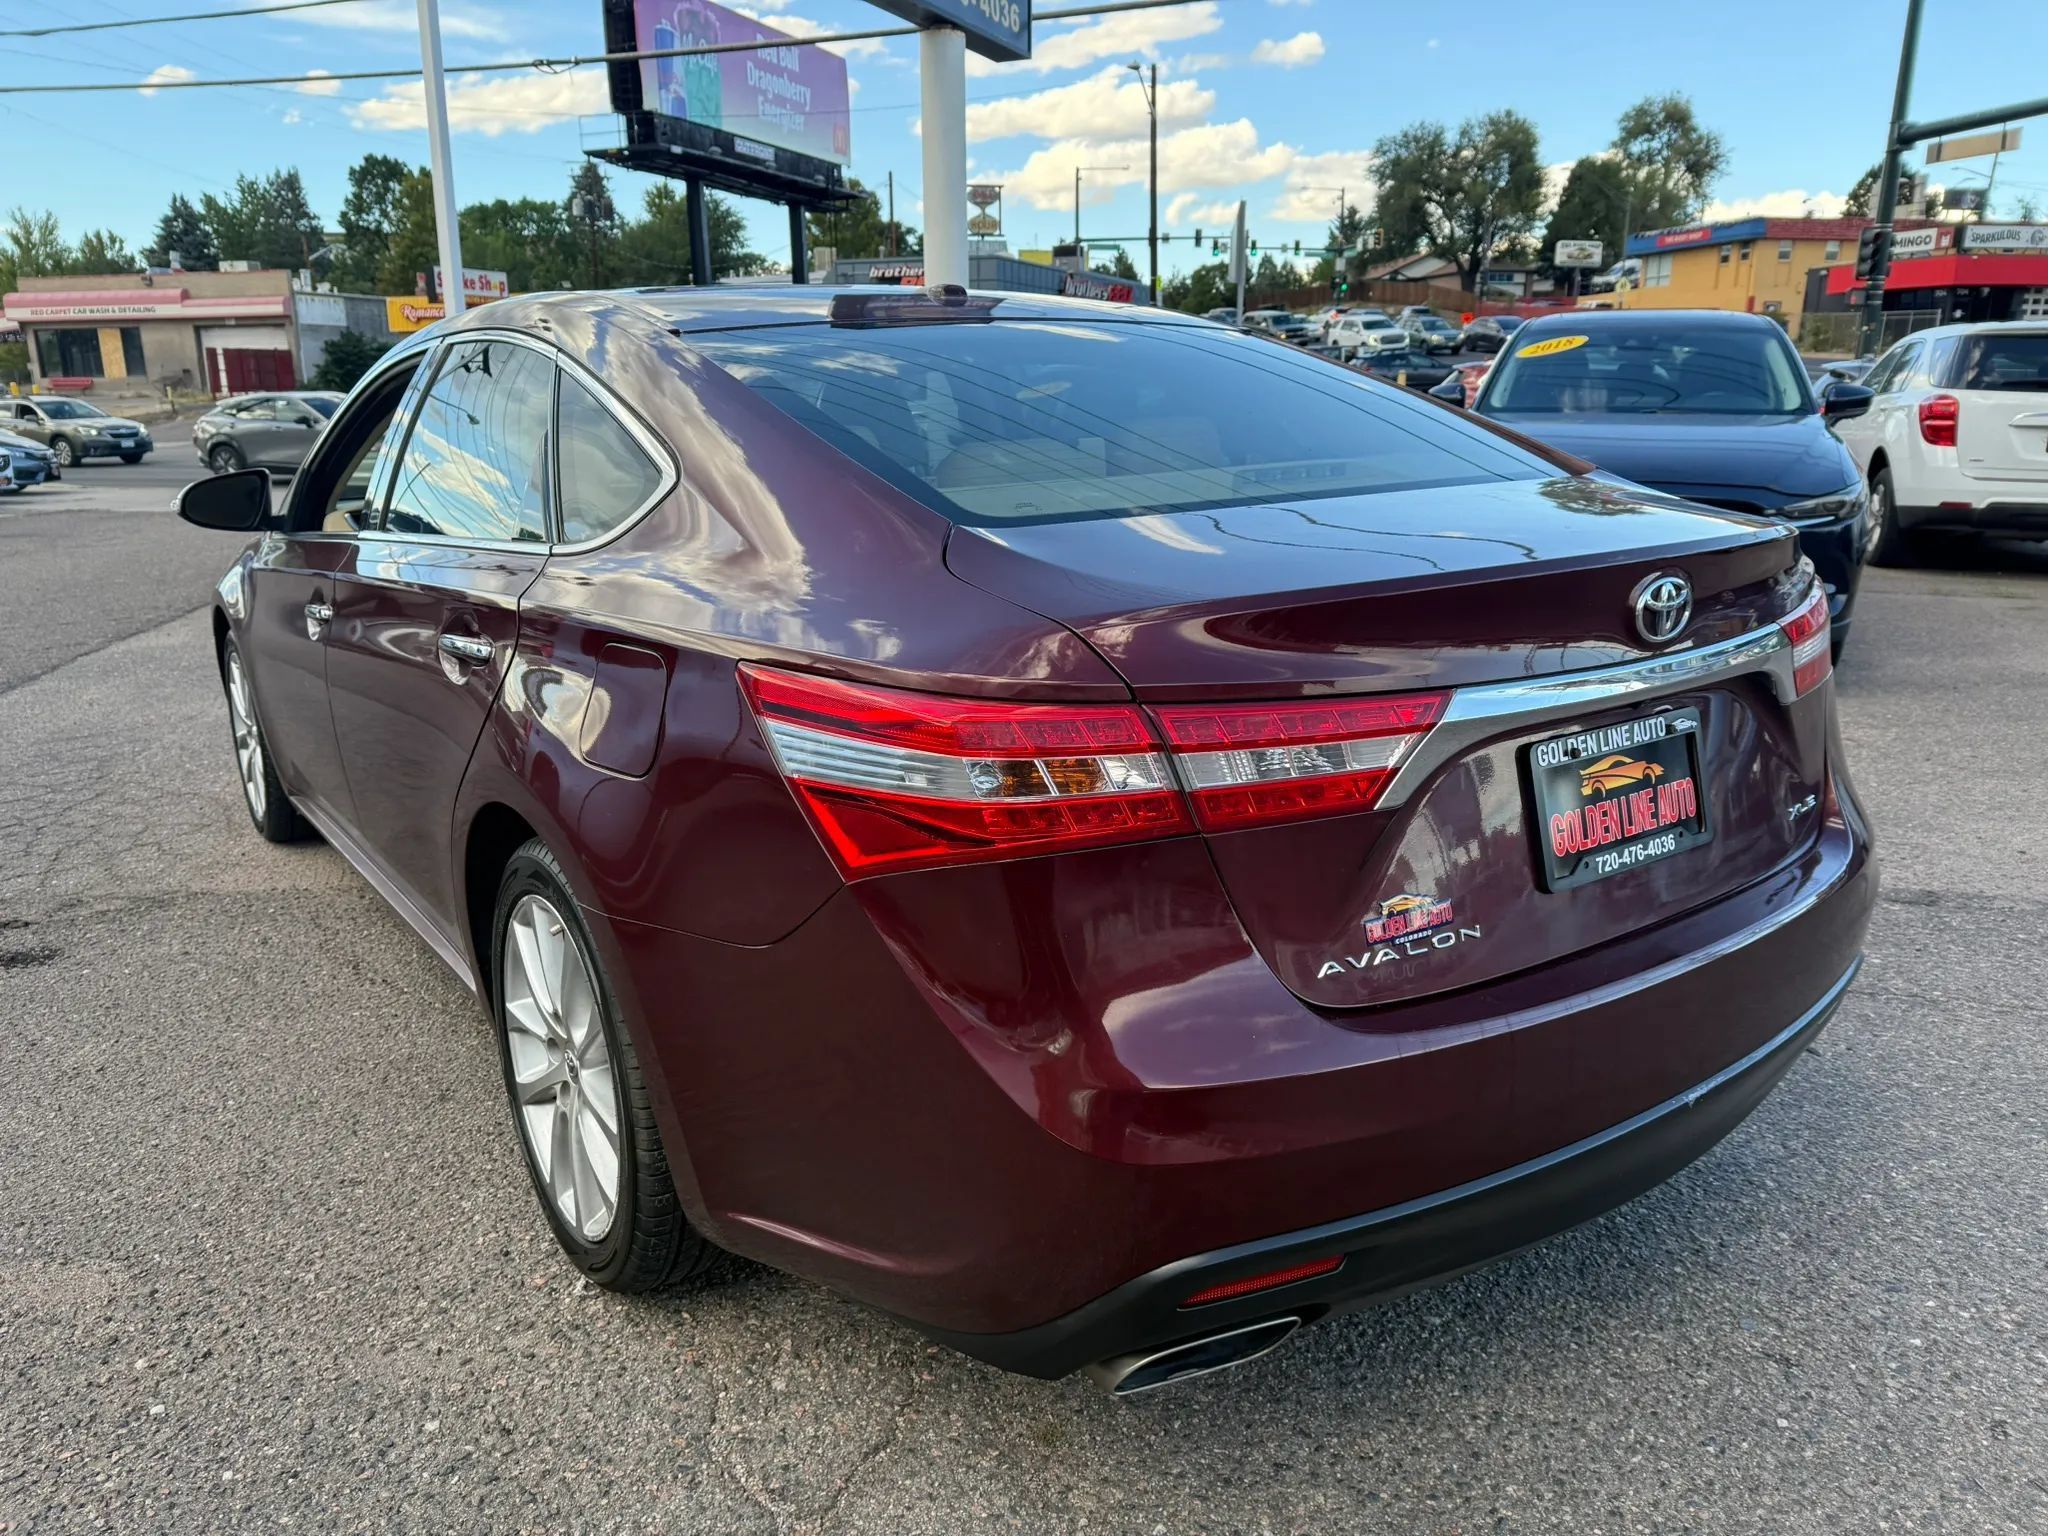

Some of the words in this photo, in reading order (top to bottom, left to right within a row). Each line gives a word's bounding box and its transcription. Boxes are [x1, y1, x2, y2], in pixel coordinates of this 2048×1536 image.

[746, 60, 811, 111] Dragonberry
[758, 96, 805, 133] Energizer
[1970, 229, 2022, 243] SPARKULOUS
[45, 308, 71, 316] CARPET
[72, 307, 88, 315] CAR
[89, 306, 110, 315] WASH
[118, 305, 157, 314] DETAILING
[1529, 337, 1576, 355] 2018
[1537, 733, 1598, 767] GOLDEN
[1600, 726, 1631, 755] LINE
[1633, 716, 1667, 745] AUTO
[1550, 799, 1621, 857] GOLDEN
[1620, 788, 1658, 838] LINE
[1657, 777, 1698, 827] AUTO
[1596, 833, 1676, 874] 720-476-4036
[1366, 914, 1407, 944] GOLDEN
[1428, 903, 1454, 927] AUTO
[1395, 929, 1433, 945] COLORADO
[1317, 925, 1481, 978] AVALON
